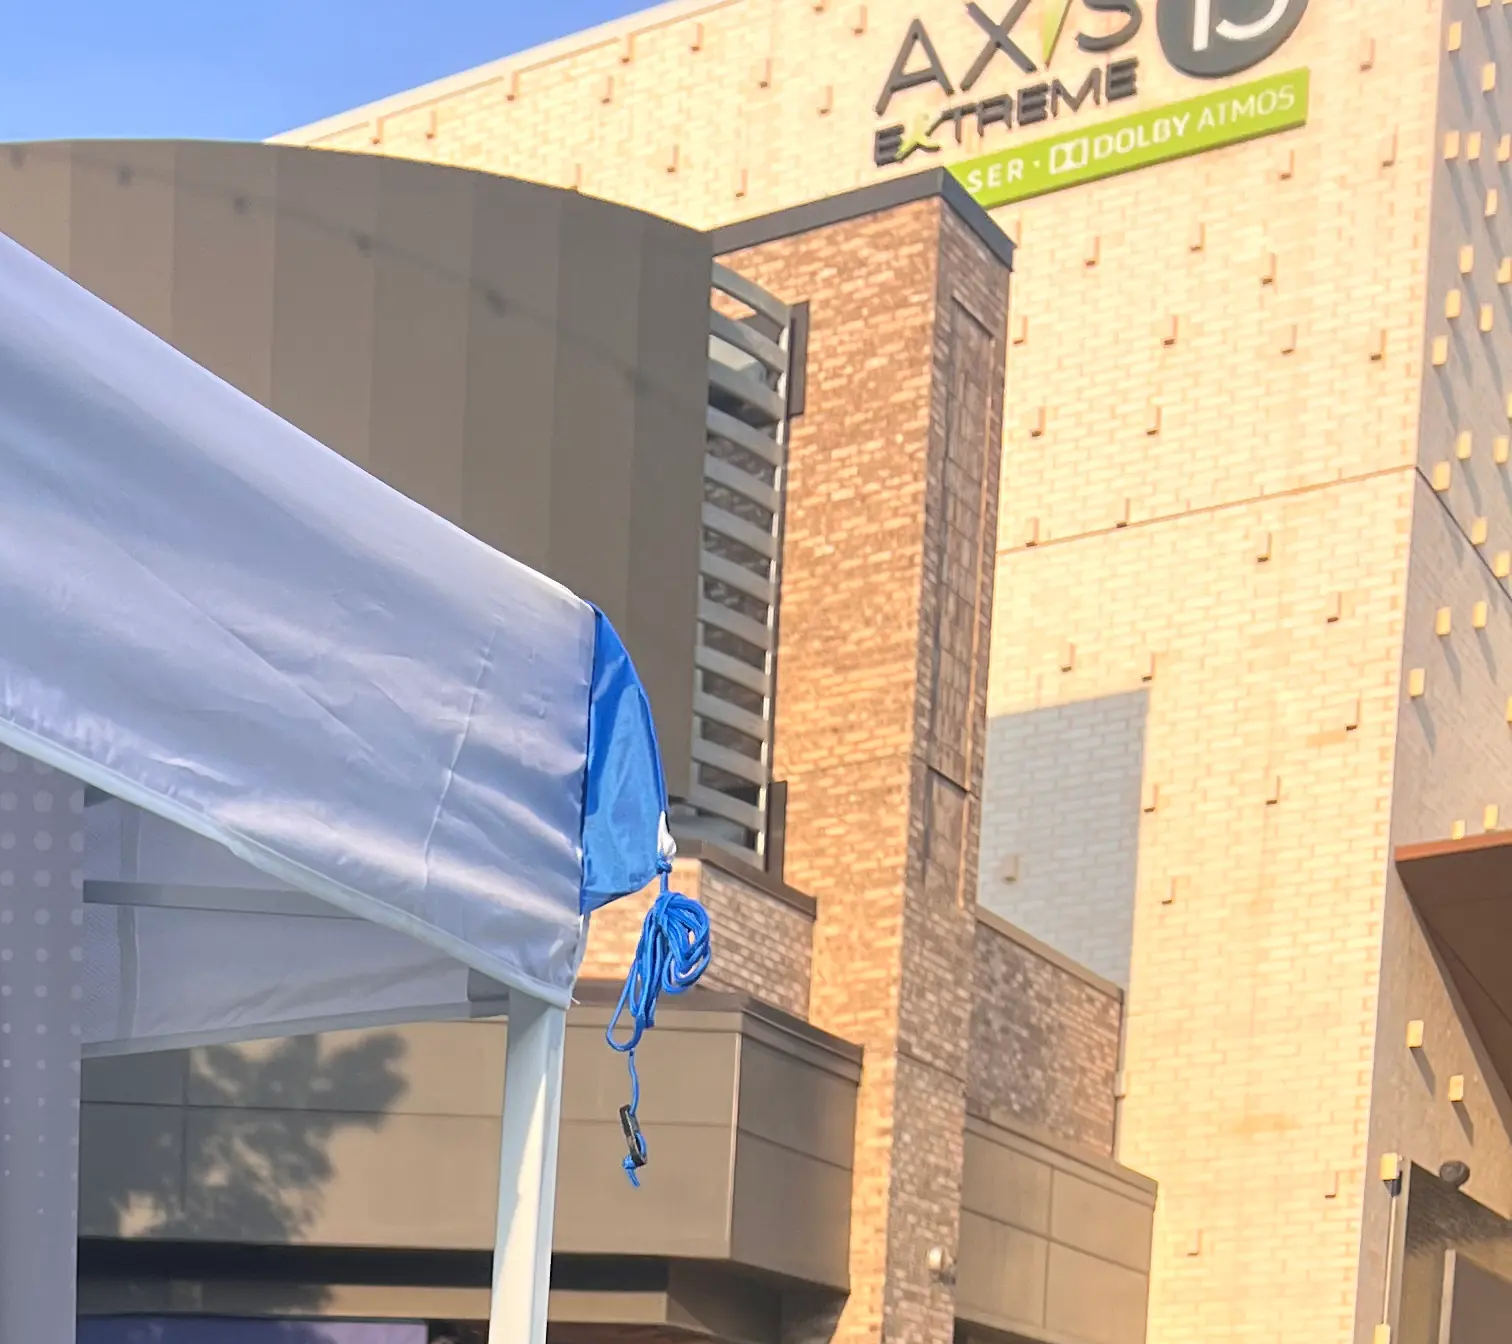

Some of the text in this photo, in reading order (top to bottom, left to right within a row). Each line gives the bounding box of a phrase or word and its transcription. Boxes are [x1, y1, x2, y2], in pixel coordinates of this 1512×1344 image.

[874, 57, 1139, 167] EXTREME
[966, 84, 1297, 195] SER DOLBY ATMOS
